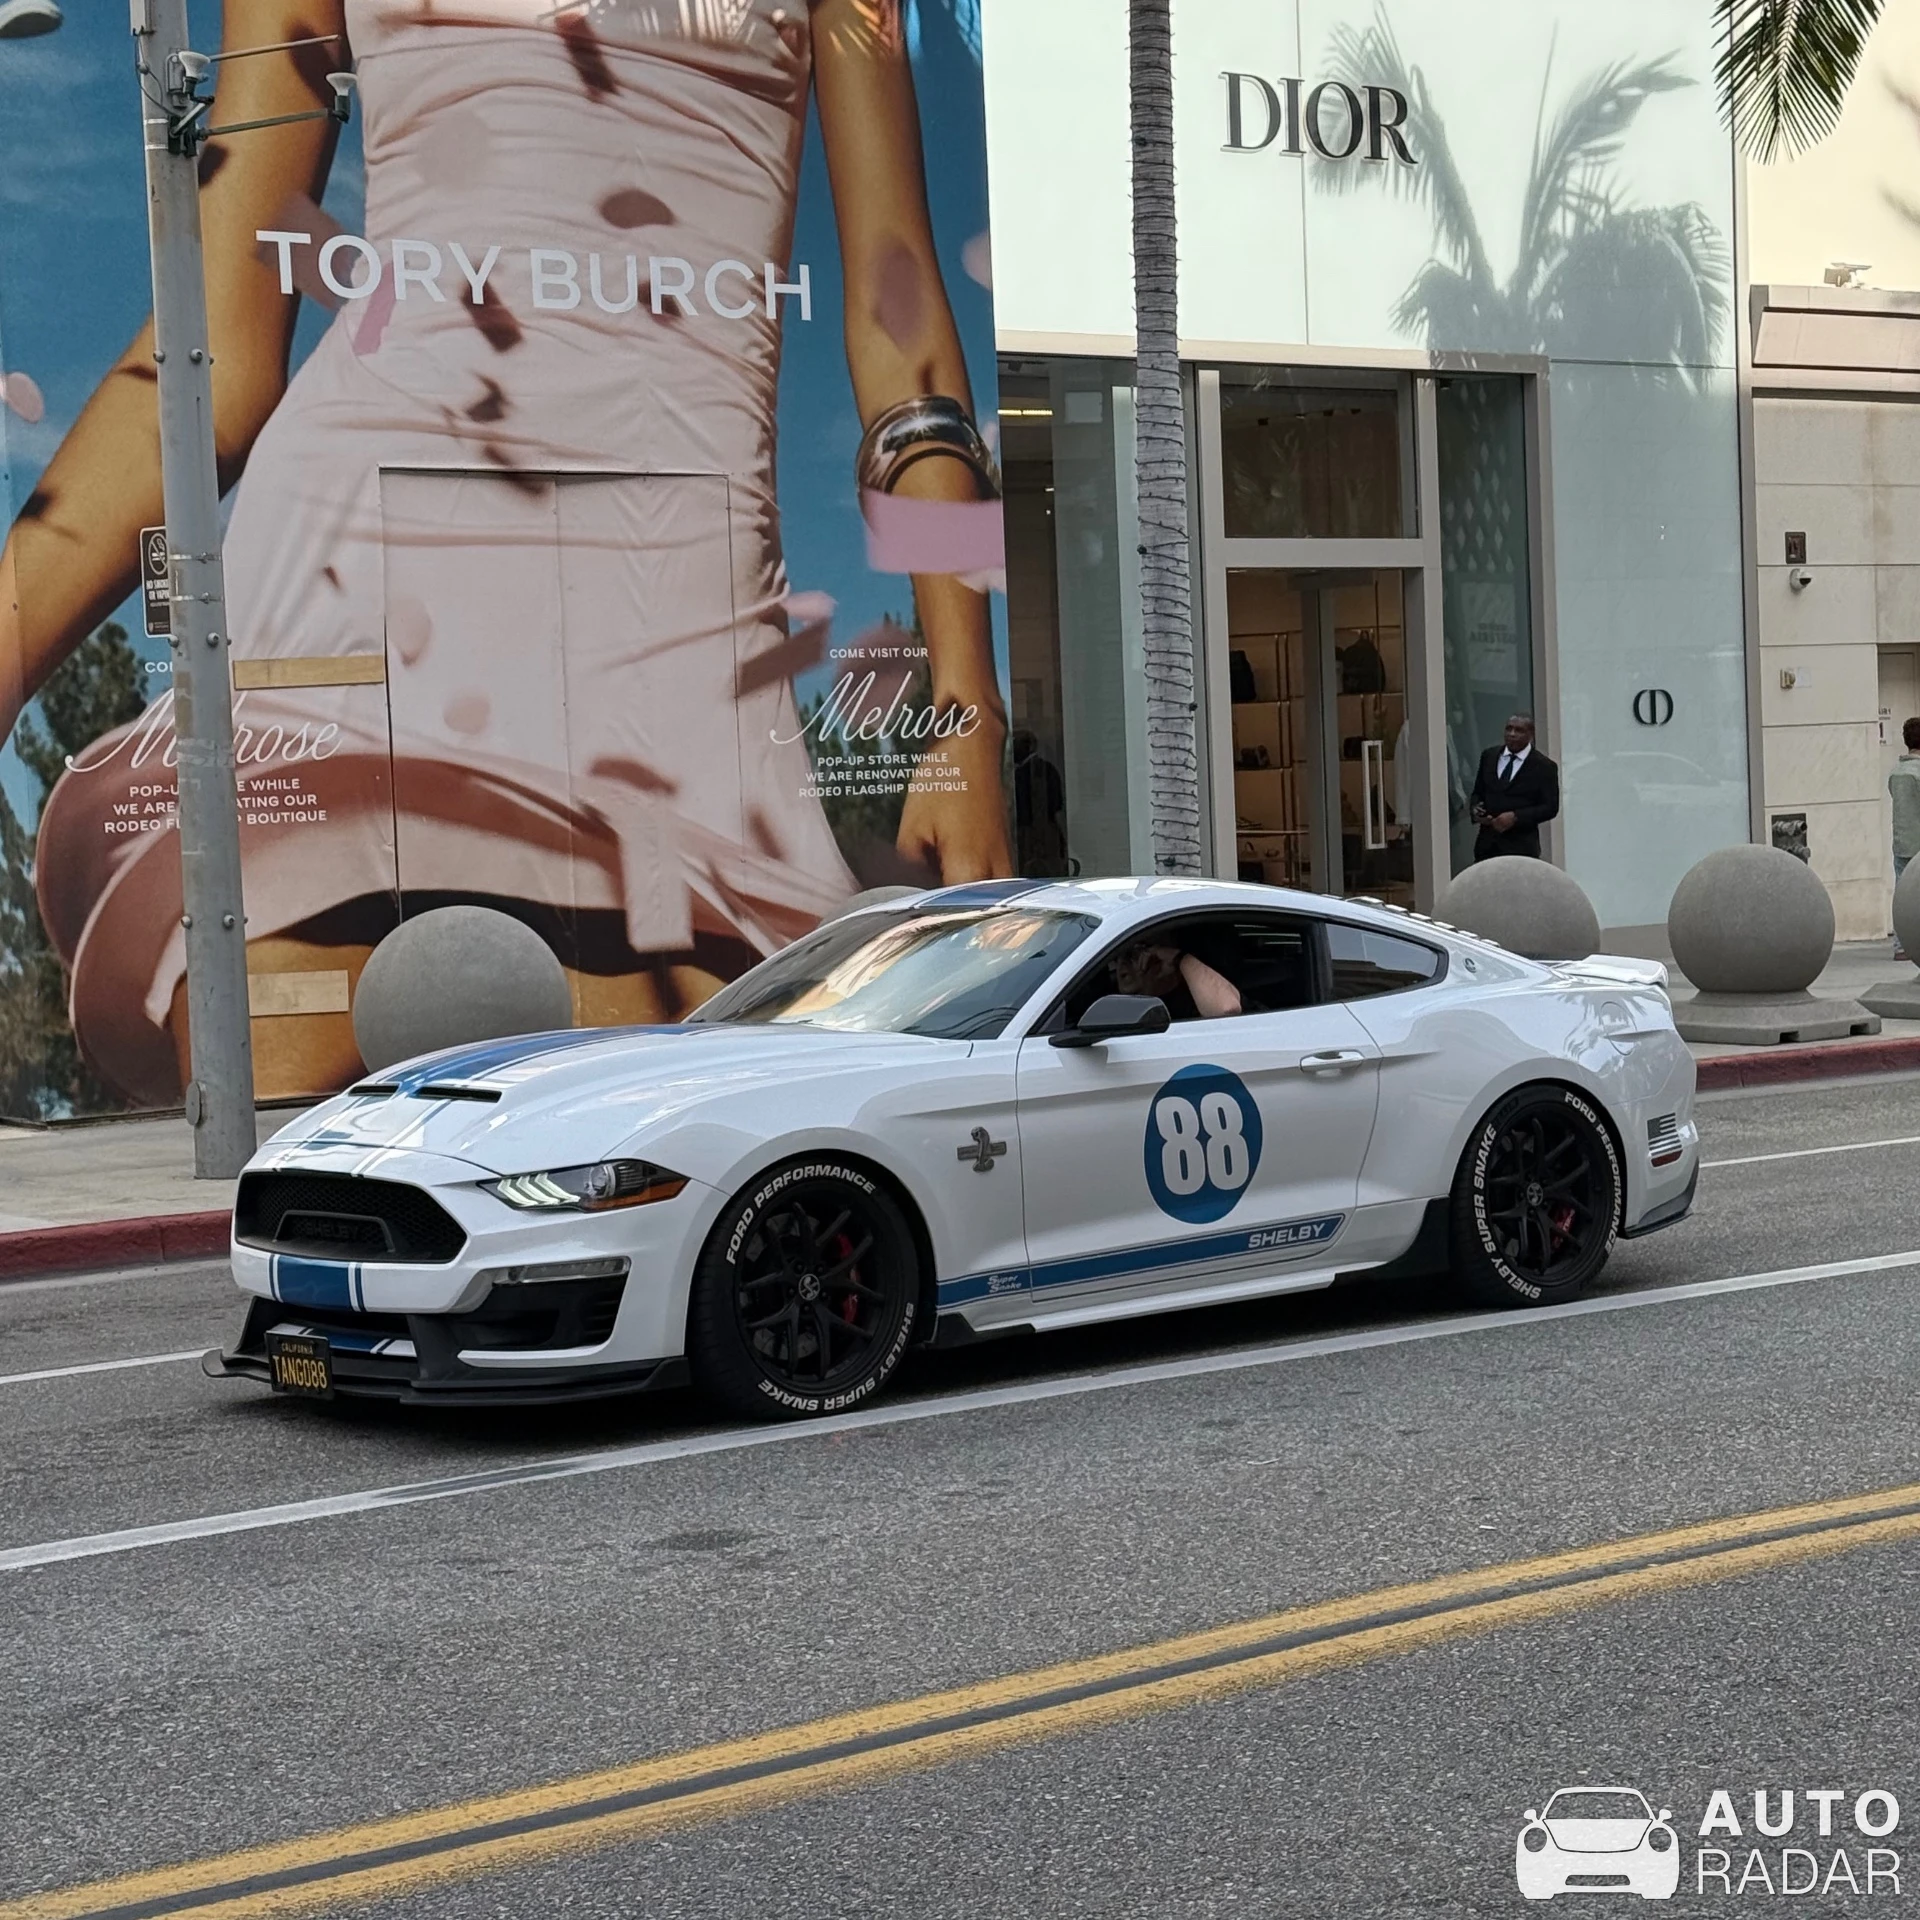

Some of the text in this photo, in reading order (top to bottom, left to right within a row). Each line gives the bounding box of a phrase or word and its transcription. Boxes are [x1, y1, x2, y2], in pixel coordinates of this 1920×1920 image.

[1219, 71, 1418, 166] DIOR
[256, 229, 811, 321] TORY BURCH
[829, 647, 929, 659] COME VISIT OUR
[769, 670, 982, 745] Melrose
[805, 766, 961, 783] WE ARE RENOVATING OUR
[817, 752, 948, 768] POP-UP STORE WHILE
[250, 778, 301, 791] WHILE
[799, 781, 969, 798] RODEO FLAGSHIP BOUTIQUE
[113, 803, 139, 816] WE
[143, 801, 176, 814] ARE
[284, 794, 317, 806] OUR
[104, 819, 161, 833] RODEO
[246, 810, 327, 825] BOUTIQUE
[1155, 1092, 1250, 1196] 88
[1564, 1091, 1623, 1253] FORD PERFORMANCE
[725, 1164, 876, 1265] FORD PERFORMANCE
[1473, 1123, 1542, 1300] SHELBY SUPER SNAKE
[1247, 1221, 1327, 1250] SHELBY
[281, 1342, 314, 1355] CALIFORNIA
[758, 1301, 914, 1411] SHELBY SUPER SNAKE
[272, 1355, 328, 1389] TANGO88
